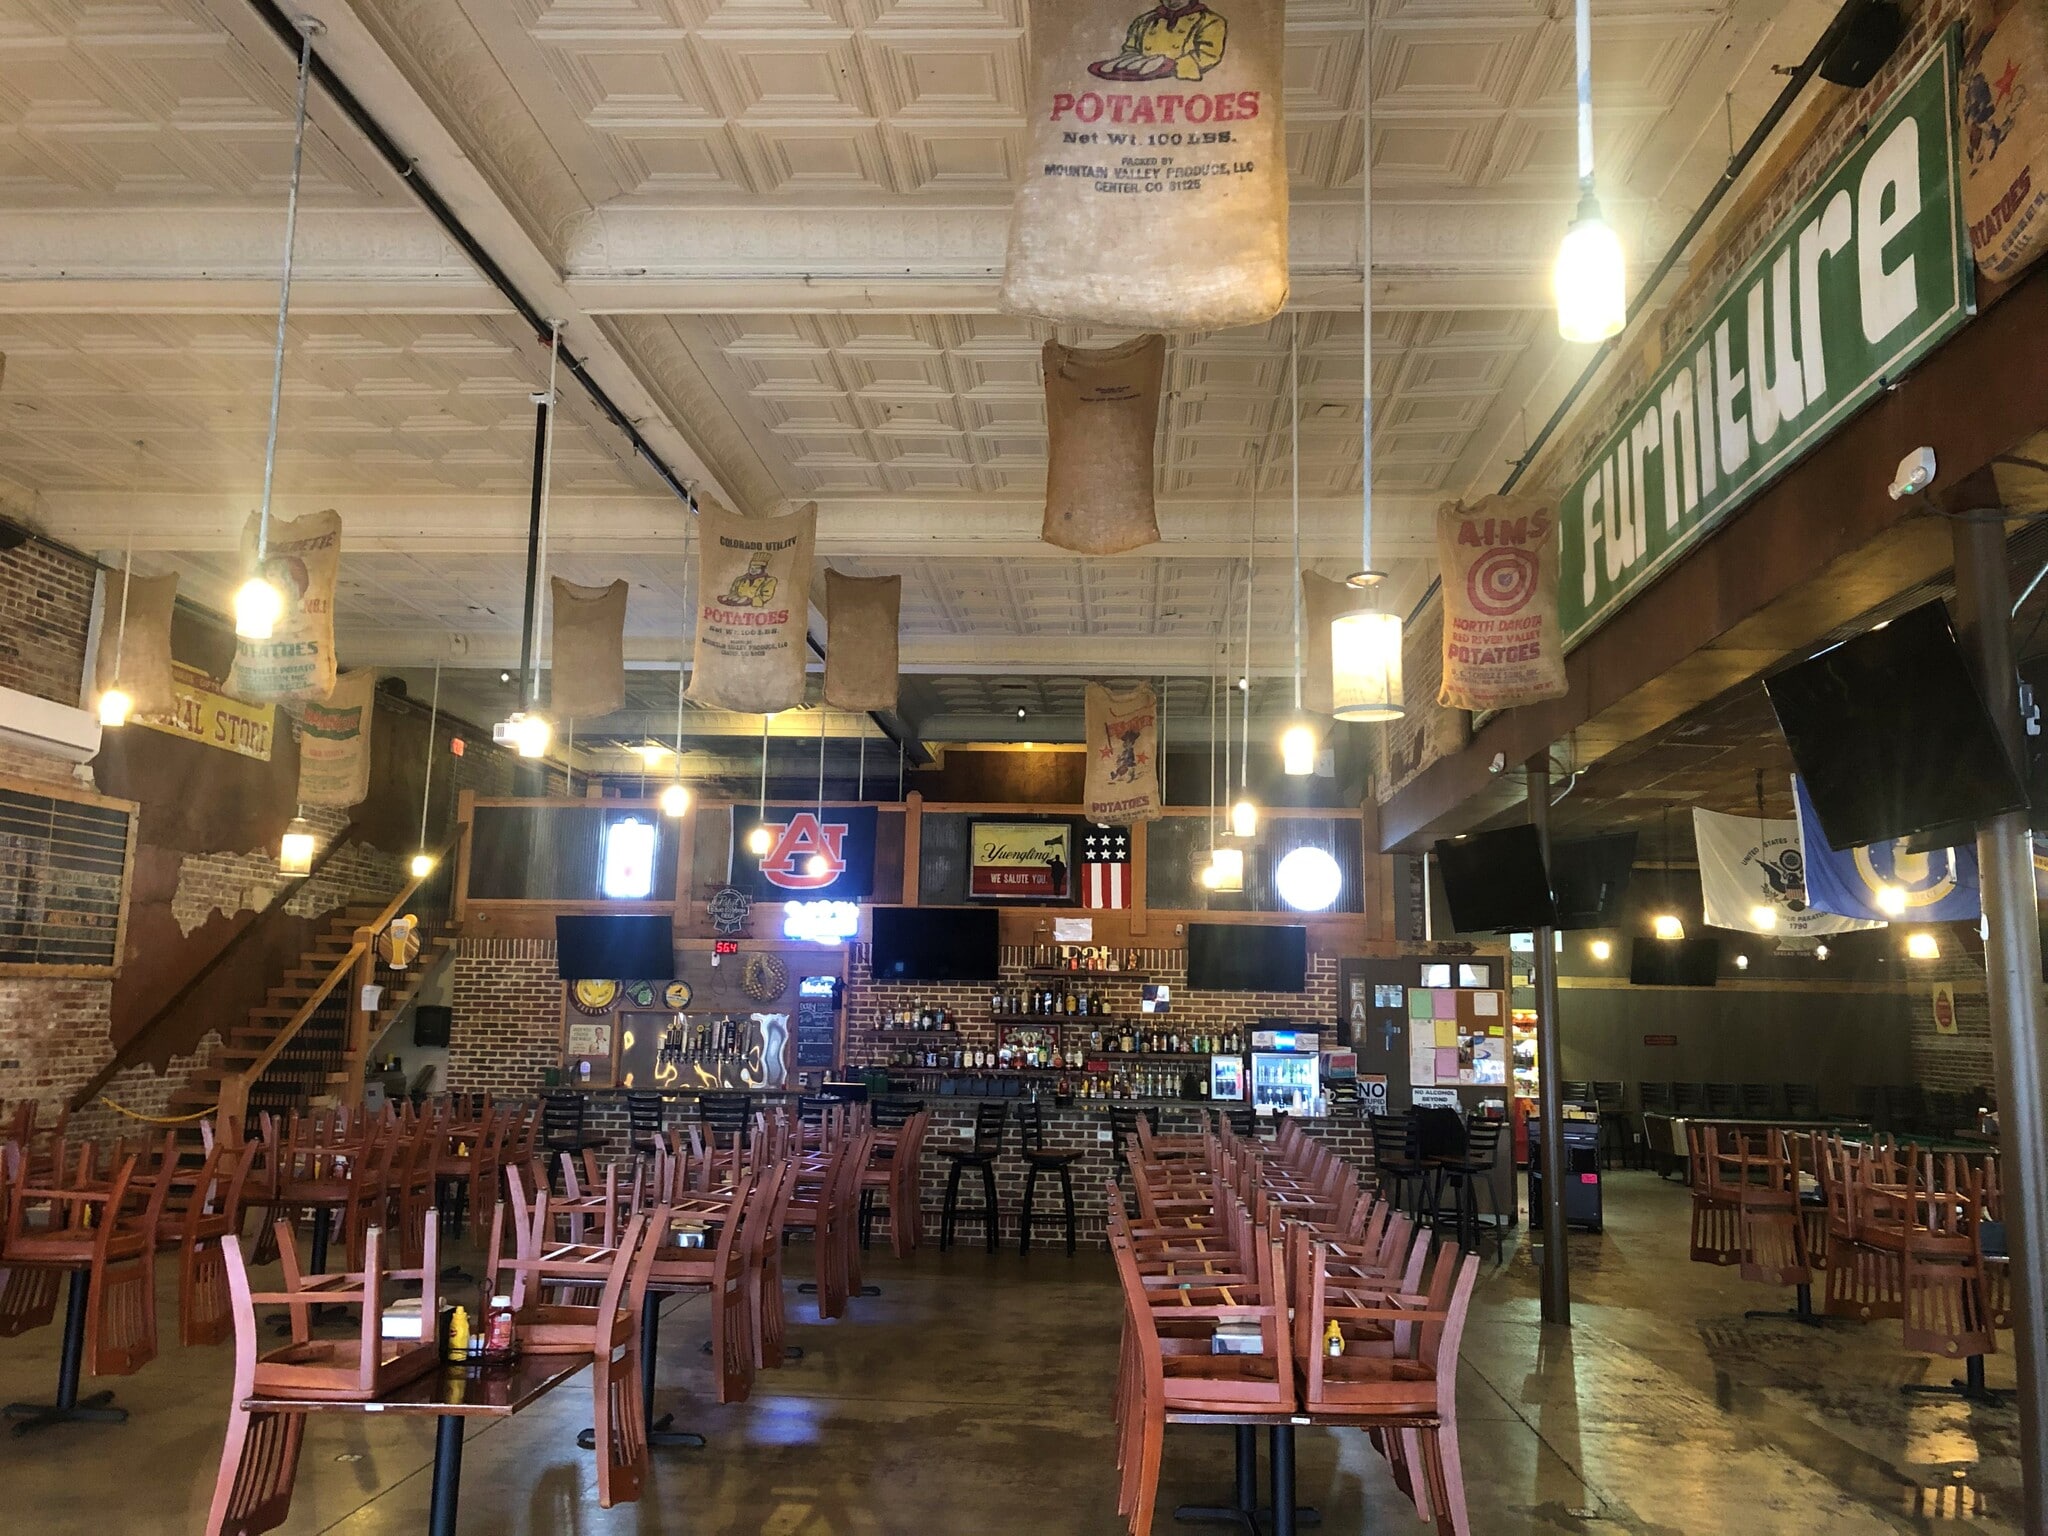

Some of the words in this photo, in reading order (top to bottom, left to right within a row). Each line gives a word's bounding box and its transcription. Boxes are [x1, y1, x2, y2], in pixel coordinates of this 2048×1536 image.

[1050, 91, 1261, 125] POTATOES
[1062, 131, 1098, 144] Net
[1149, 133, 1183, 146] 100
[1121, 157, 1158, 166] PACKED
[1161, 157, 1174, 165] BY
[1044, 164, 1108, 178] MOUNTAIN
[1113, 167, 1161, 180] VALLEY
[1234, 161, 1254, 173] LLC
[1145, 182, 1163, 193] CO
[719, 536, 763, 550] COLORADO
[766, 536, 797, 551] UTILITY
[703, 606, 789, 626] POTATOES
[1453, 617, 1494, 632] NORTH
[1499, 615, 1542, 632] DAKOTA
[1453, 632, 1470, 643] RED
[1472, 635, 1503, 644] RIVER
[1507, 630, 1541, 641] VALLEY
[1448, 641, 1541, 665] POTATOES
[1092, 796, 1150, 813] POTATOES
[981, 843, 1050, 863] Yuengling
[1741, 847, 1760, 866] UNITED
[1763, 838, 1788, 848] STATES
[990, 873, 1001, 884] WE
[1004, 873, 1029, 884] SALUTE
[1789, 922, 1808, 930] 1790
[1350, 982, 1366, 1041] EAT
[1359, 1083, 1385, 1098] NO
